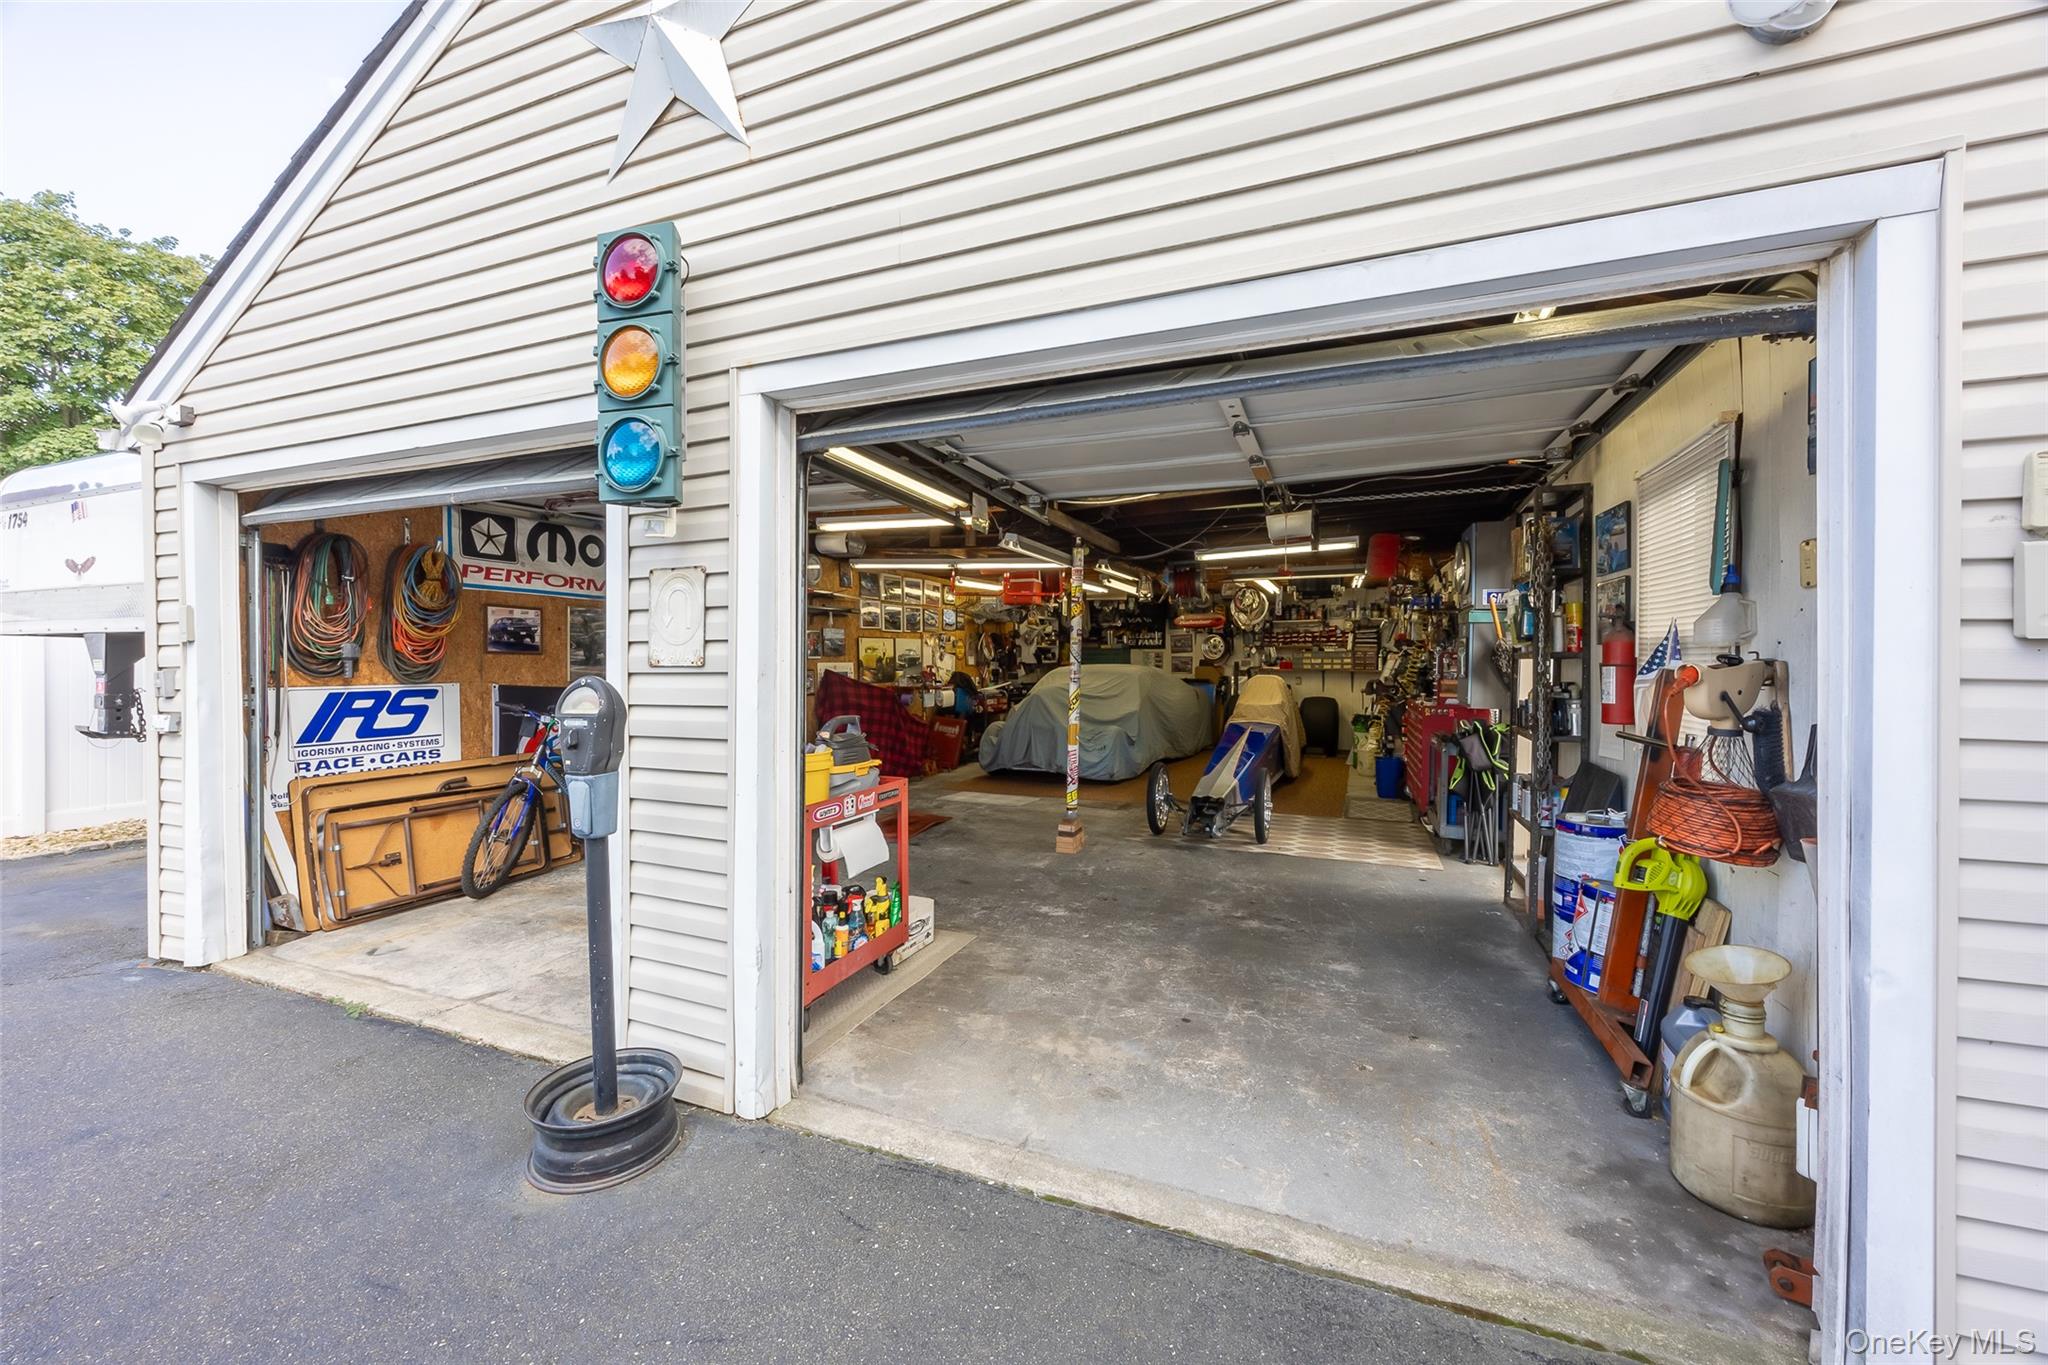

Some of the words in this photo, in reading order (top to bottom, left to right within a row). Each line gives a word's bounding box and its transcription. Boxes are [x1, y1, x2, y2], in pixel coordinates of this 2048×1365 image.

[8, 511, 28, 529] 1754
[296, 688, 439, 744] IRS
[297, 746, 345, 758] IGORISM
[352, 742, 390, 753] RACING
[397, 738, 440, 748] SYSTEMS
[295, 756, 364, 774] RACE
[380, 749, 441, 764] CARS
